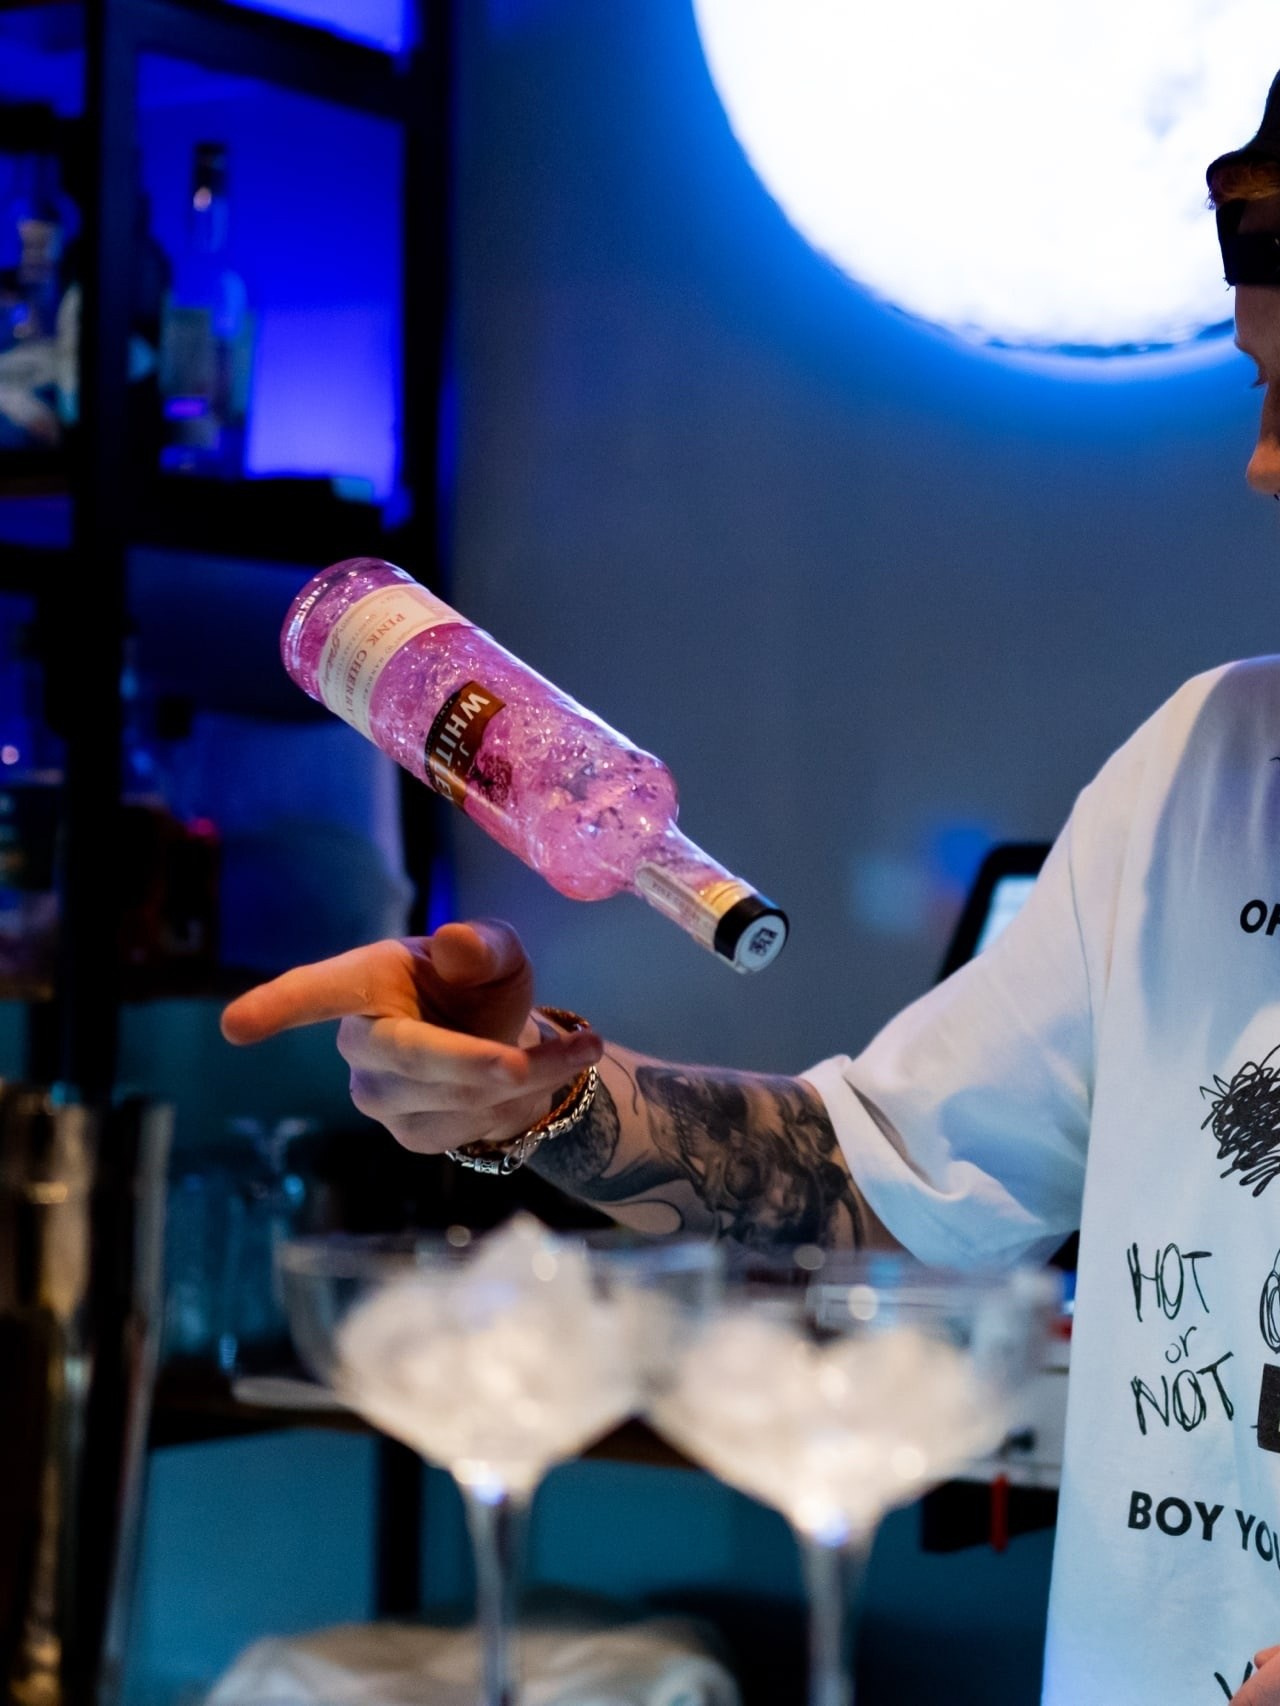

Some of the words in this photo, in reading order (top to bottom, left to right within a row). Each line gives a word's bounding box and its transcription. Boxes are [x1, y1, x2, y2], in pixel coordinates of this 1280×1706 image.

[366, 612, 406, 646] PINK
[344, 649, 368, 712] CHERRY
[1127, 1242, 1212, 1322] HOT
[1165, 1326, 1197, 1363] or
[1131, 1353, 1234, 1435] NOT
[1127, 1490, 1224, 1542] BOY
